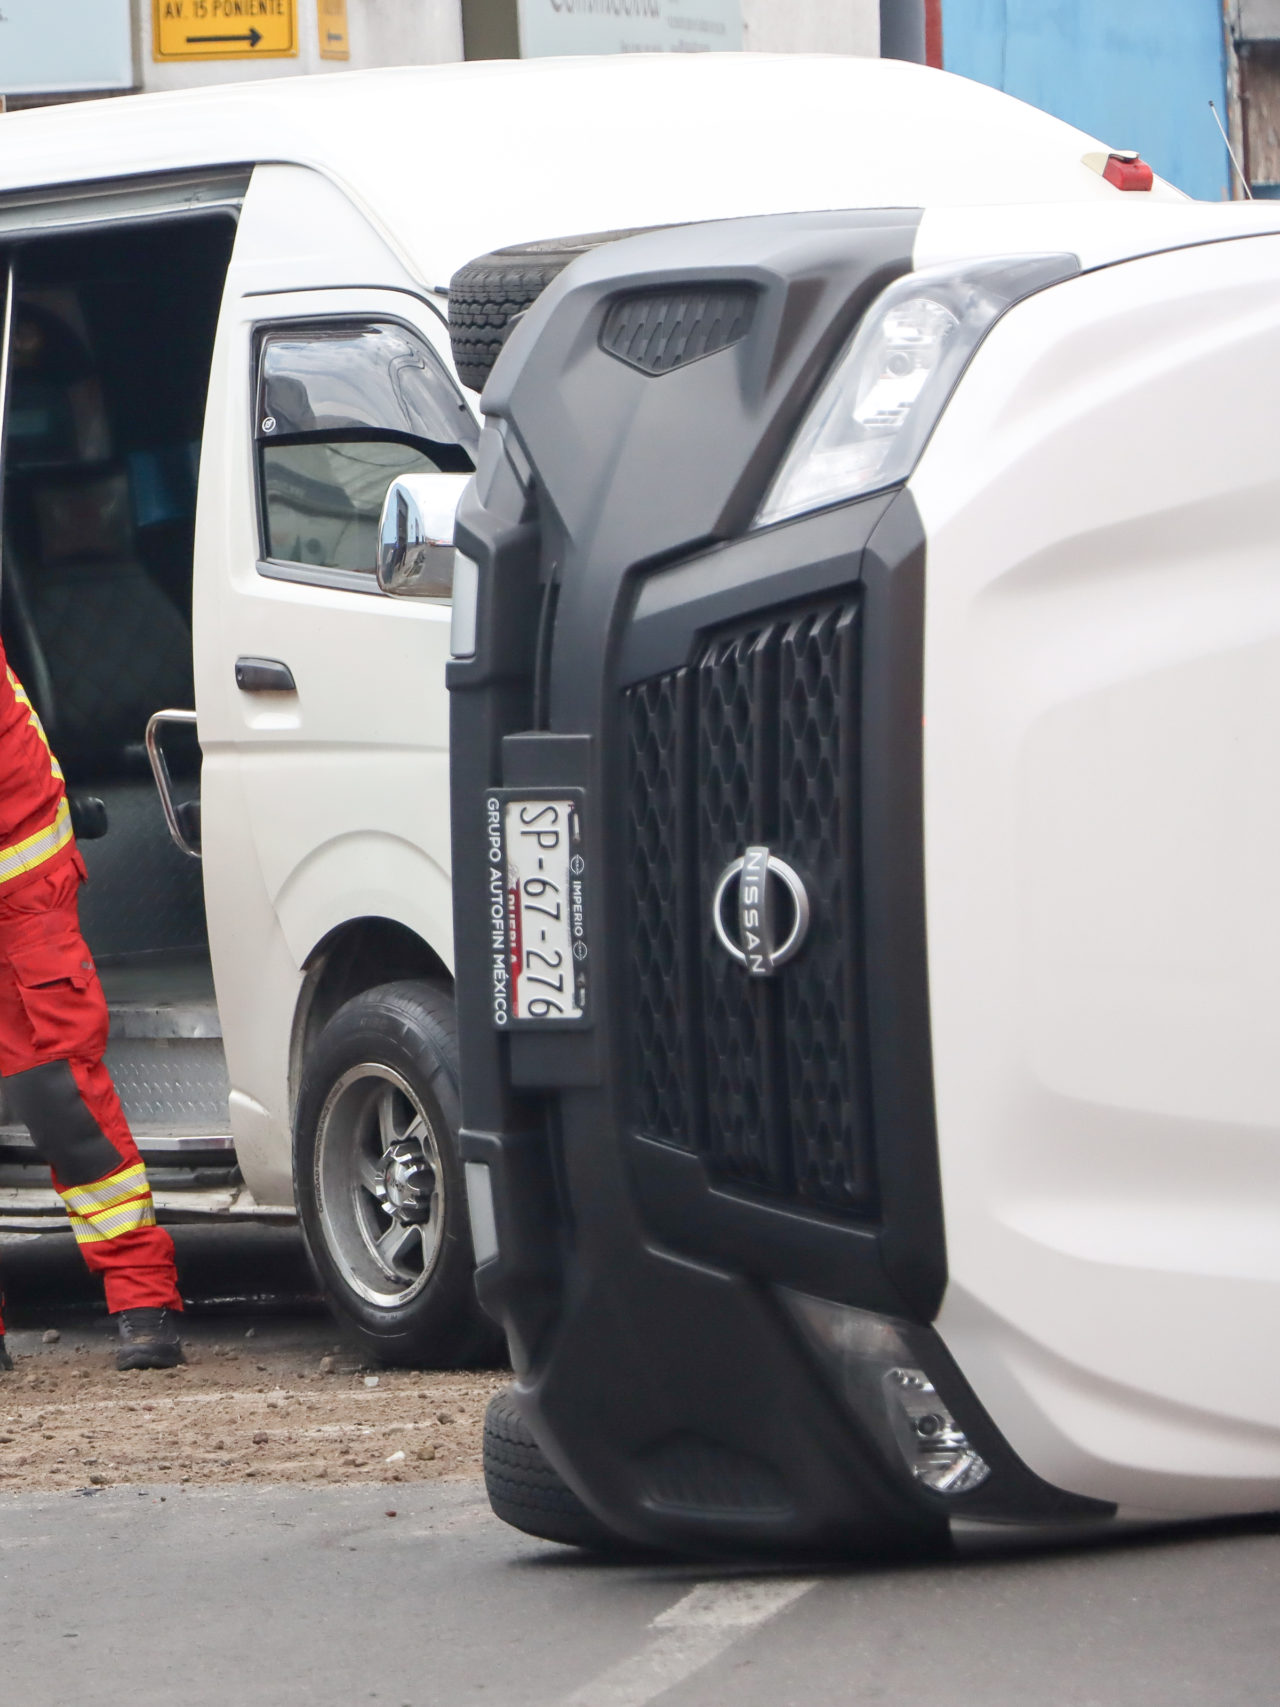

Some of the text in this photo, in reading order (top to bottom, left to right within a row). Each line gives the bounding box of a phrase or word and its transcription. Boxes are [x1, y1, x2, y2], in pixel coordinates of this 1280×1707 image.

[486, 796, 509, 1025] GRUPO AUTOFIN MÉXICO
[520, 805, 565, 1018] SP-67-276
[573, 880, 584, 937] IMPERIO
[744, 852, 766, 973] NISSAN
